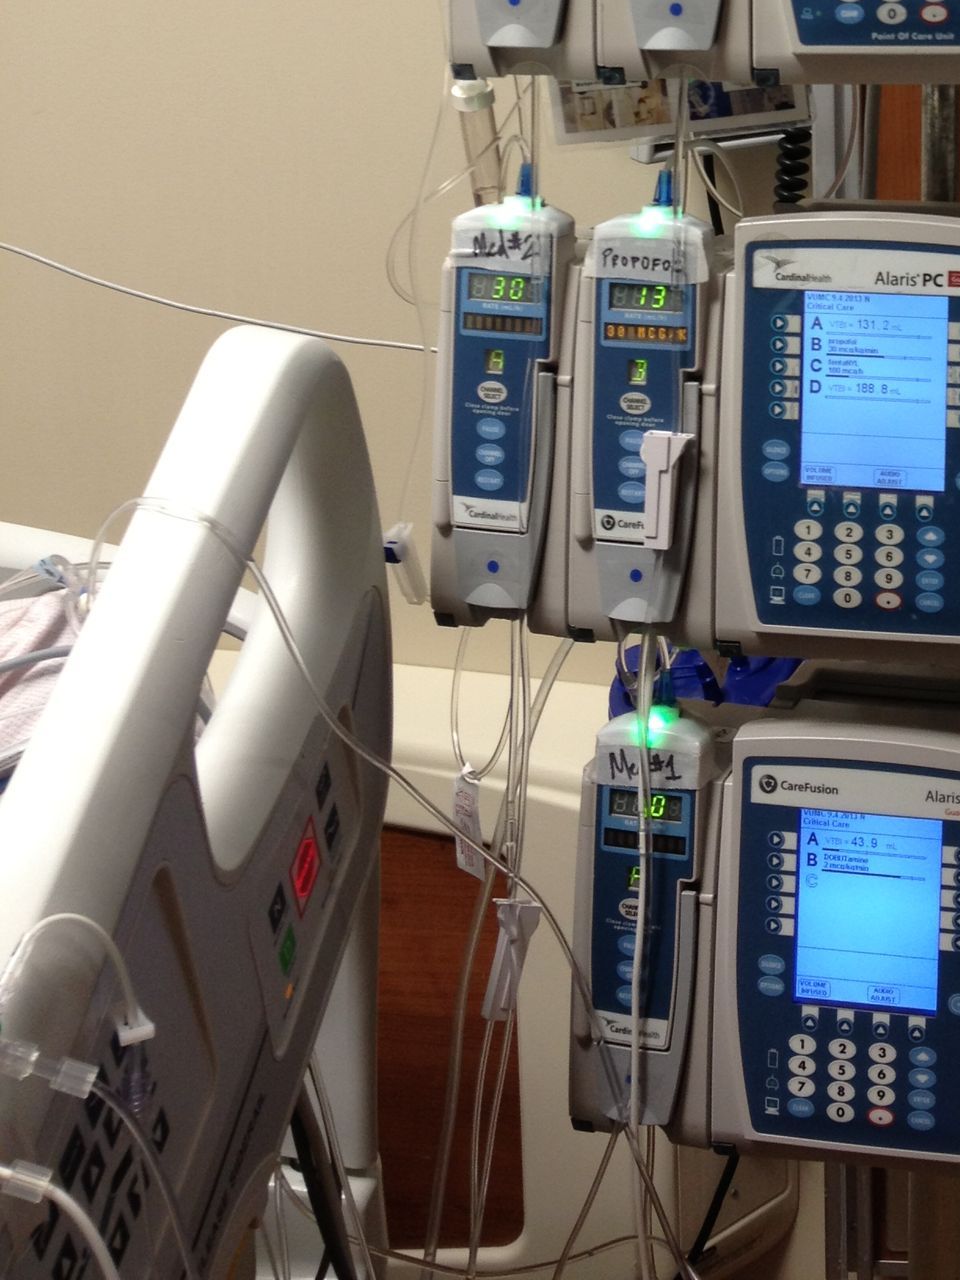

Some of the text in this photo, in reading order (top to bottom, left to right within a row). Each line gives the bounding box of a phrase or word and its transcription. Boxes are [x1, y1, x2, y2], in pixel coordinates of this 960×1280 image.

[888, 8, 896, 20] 0
[871, 32, 955, 41] Point Of Care Unit
[775, 272, 832, 283] CardinalHealth
[922, 274, 944, 288] PC
[492, 277, 525, 300] 30
[639, 286, 667, 308] 13
[807, 303, 835, 311] Critical
[811, 317, 890, 332] A 131.2
[811, 338, 822, 352] B
[810, 359, 823, 372] C
[810, 381, 889, 395] D 188.8
[469, 510, 517, 520] CardinalHealth
[845, 527, 853, 537] 2
[886, 529, 894, 540] 3
[804, 547, 893, 562] 4 5 6
[804, 569, 893, 584] 7 8 9
[844, 593, 852, 604] 0
[780, 780, 839, 795] CareFusion
[803, 818, 830, 827] Critical
[807, 832, 819, 846] A
[850, 836, 879, 849] 43.9
[807, 854, 869, 866] B DOBUTamine
[806, 873, 818, 888] C
[838, 1043, 847, 1054] 2
[878, 1048, 886, 1058] 3
[798, 1060, 886, 1080] 4 5 6
[798, 1082, 886, 1101] 7 8 9
[836, 1107, 845, 1118] 0
